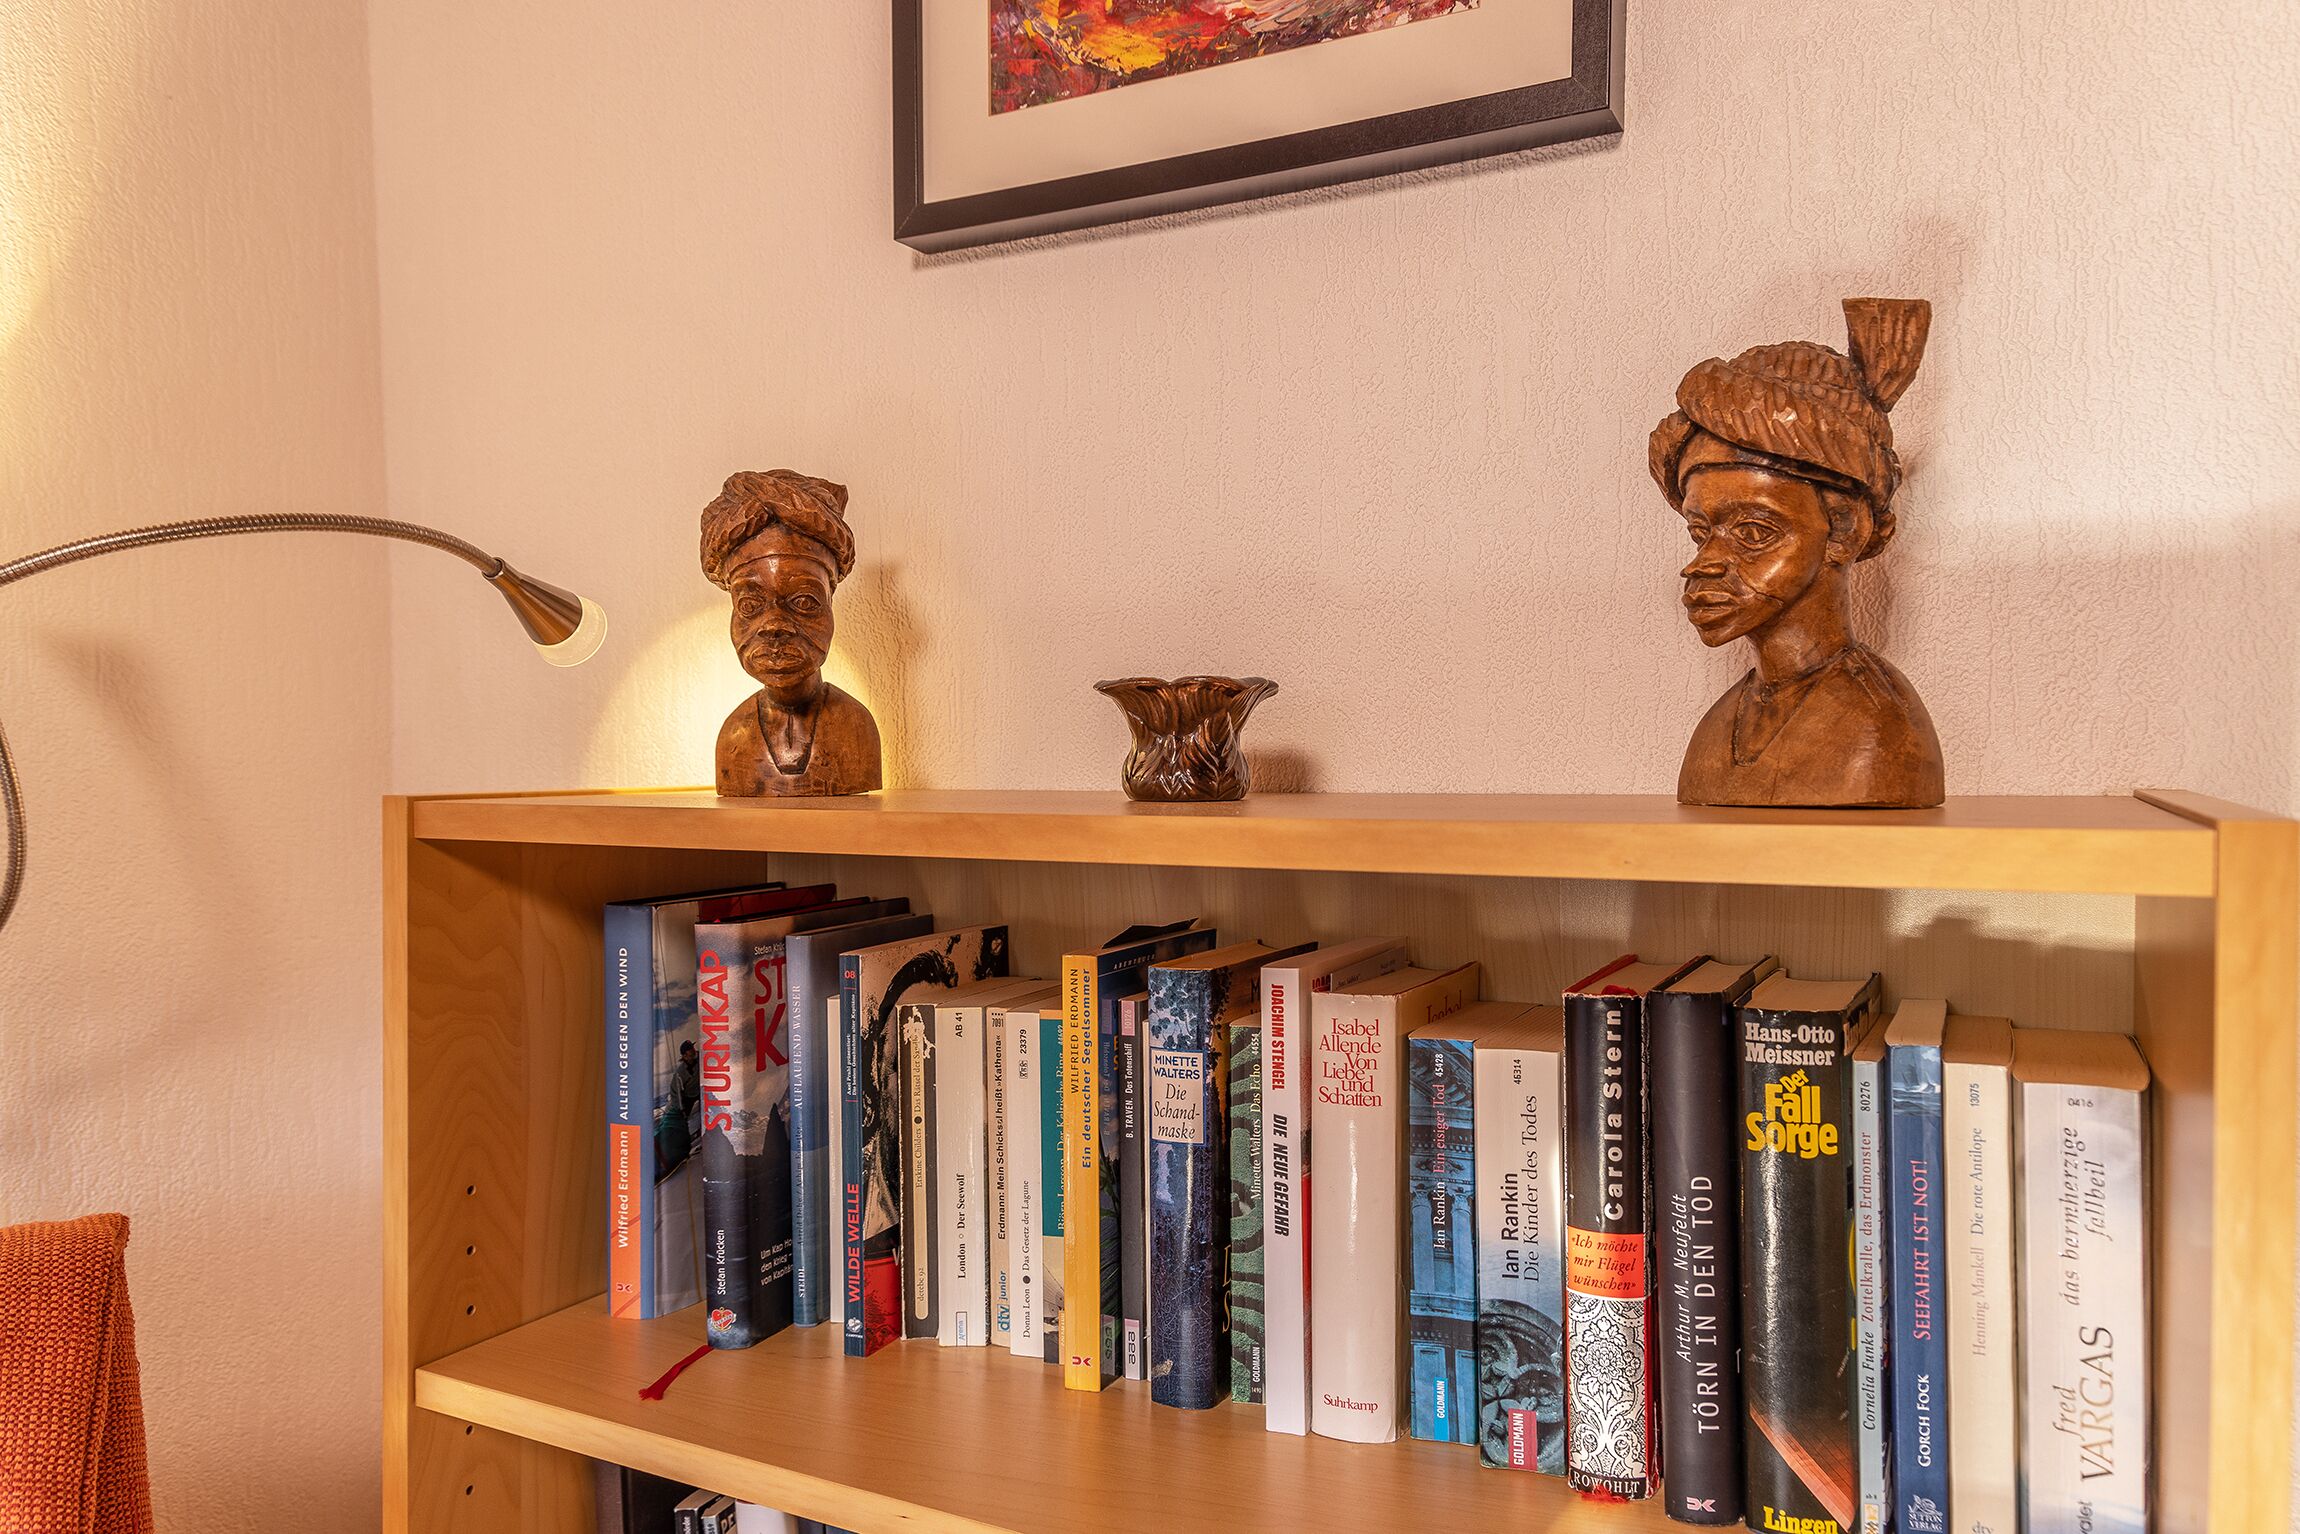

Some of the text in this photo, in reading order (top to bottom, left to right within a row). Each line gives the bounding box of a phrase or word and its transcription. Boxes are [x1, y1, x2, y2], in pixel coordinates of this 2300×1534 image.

[754, 956, 787, 1005] ST
[844, 969, 856, 979] 08
[619, 946, 629, 1120] ALLEIN GEGEN DEN WIND
[955, 1012, 963, 1038] AB 41
[1070, 968, 1079, 1094] WILFRIED ERDMANN
[1123, 1009, 1132, 1030] 10126
[1271, 983, 1285, 1090] JOACHIM STENGEL
[1331, 1018, 1380, 1037] Isabel
[1744, 1021, 1836, 1045] Hans-Otto
[700, 949, 733, 1131] STURMKAP
[792, 985, 803, 1109] AUFLAUFEND WASSER
[1019, 1028, 1028, 1055] 23379
[1251, 1033, 1260, 1056] 44554
[1319, 1035, 1382, 1054] Allende
[1744, 1041, 1836, 1066] Meissner
[992, 1035, 1003, 1088] »Kathena«
[1081, 968, 1092, 1169] Ein deutscher Segelsommer
[1153, 1066, 1201, 1080] WALTERS
[1155, 1055, 1199, 1068] MINETTE
[1323, 1061, 1365, 1081] Liebe
[1345, 1053, 1378, 1070] Von
[1434, 1053, 1444, 1078] 45428
[1512, 1059, 1522, 1085] 46314
[1778, 1067, 1810, 1093] Der
[994, 1088, 1003, 1114] heißt
[1123, 1043, 1134, 1138] B. TRAVEN. Das Totenschiff
[1165, 1083, 1188, 1101] Die
[1318, 1086, 1382, 1107] Schatten
[1341, 1075, 1374, 1092] und
[1764, 1083, 1822, 1124] Fall
[1859, 1081, 1871, 1113] 80276
[1969, 1083, 1980, 1107] 13075
[911, 1061, 923, 1188] Erskine Childers Das Rätsel der
[1153, 1100, 1201, 1120] Schand-
[1158, 1121, 1197, 1139] maske
[1602, 1010, 1624, 1221] Carola Stern
[1056, 1131, 1064, 1151] Der
[1249, 1063, 1262, 1200] Minette Walters Das Echo
[1745, 1112, 1838, 1159] Sorge
[996, 1167, 1005, 1190] Mein
[1273, 1113, 1290, 1237] DIE NEUE GEFAHR
[1432, 1084, 1449, 1249] Ian Rankin Ein eisiger Tod
[616, 1130, 629, 1249] Wilfried Erdmann
[1520, 1095, 1540, 1283] Die Kinder des Todes
[2083, 1160, 2113, 1242] fallbeil
[956, 1173, 966, 1279] London Der Seewolf
[997, 1193, 1006, 1240] Erdmann:
[1500, 1173, 1520, 1279] Ian Rankin
[2058, 1126, 2086, 1306] das barmherzige
[714, 1229, 727, 1295] Stefan Krücken
[846, 1183, 861, 1304] WILDE WELLE
[1021, 1180, 1032, 1338] Donna Leon Das Gesetz der Lagune
[1596, 1239, 1639, 1253] möchte
[1909, 1159, 1931, 1341] SEEFAHRT IST NOT!
[1968, 1127, 1989, 1357] Henning Mankell Die rote Antilope
[798, 1266, 806, 1298] STEIDL
[1574, 1255, 1637, 1276] mir Flügel
[1671, 1193, 1692, 1363] Arthur M. Neufeldt
[1858, 1131, 1876, 1431] Cornelia Funke Zottelkralle, das Erdmonster
[917, 1278, 925, 1302] detebe
[997, 1271, 1010, 1332] dtv junior
[1690, 1176, 1720, 1435] TÖRN IN DEN TOD
[1252, 1346, 1261, 1383] GOLDMANN
[1323, 1393, 1379, 1414] Suhrkamp
[1436, 1380, 1446, 1419] GOLDMANN
[2051, 1385, 2086, 1442] fred
[2078, 1326, 2114, 1482] VARGAS
[1512, 1412, 1525, 1466] GOLDMANN
[1916, 1374, 1932, 1468] GORCH FOCK
[1573, 1471, 1641, 1493] ROWOHLT
[1763, 1505, 1838, 1534] Lingen
[1908, 1519, 1943, 1531] VERLAG
